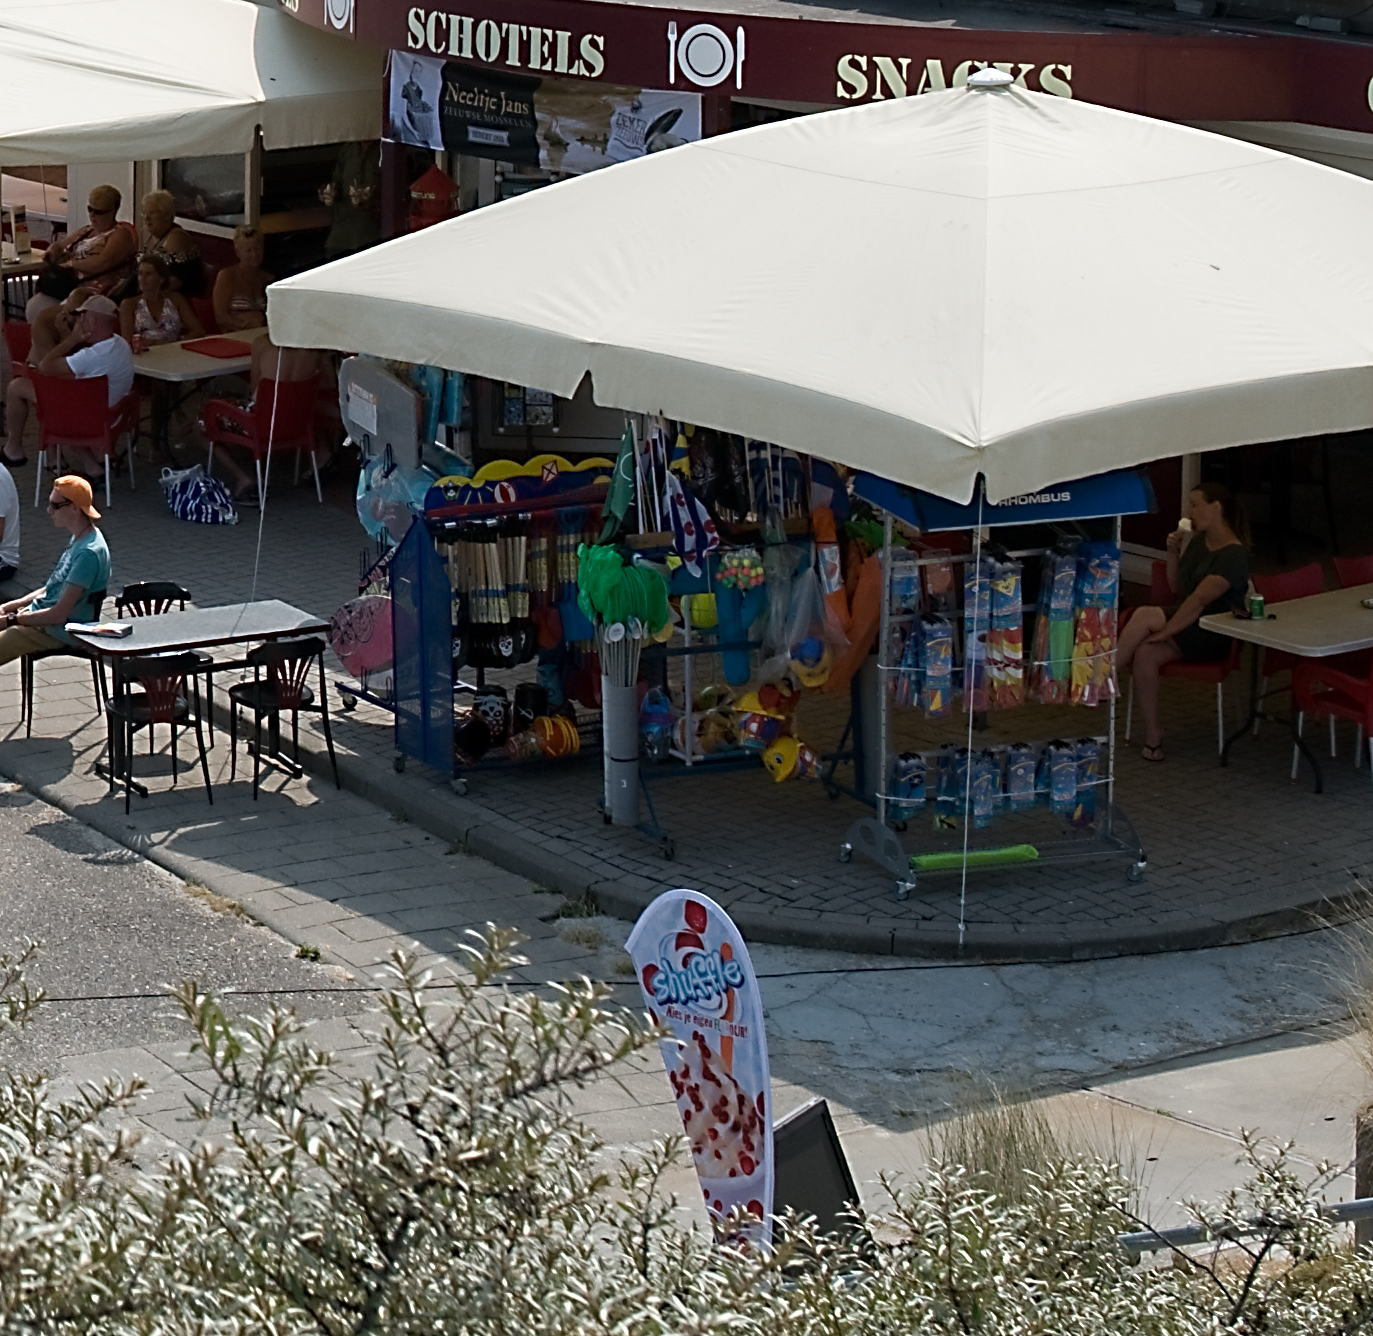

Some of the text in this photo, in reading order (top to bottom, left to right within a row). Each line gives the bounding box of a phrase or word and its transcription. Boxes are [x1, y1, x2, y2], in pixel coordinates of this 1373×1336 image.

[407, 6, 606, 78] SCHOTELS
[445, 81, 530, 116] Neeltje Jans
[652, 949, 745, 1006] shuffle
[714, 1017, 749, 1039] FLOUR!
